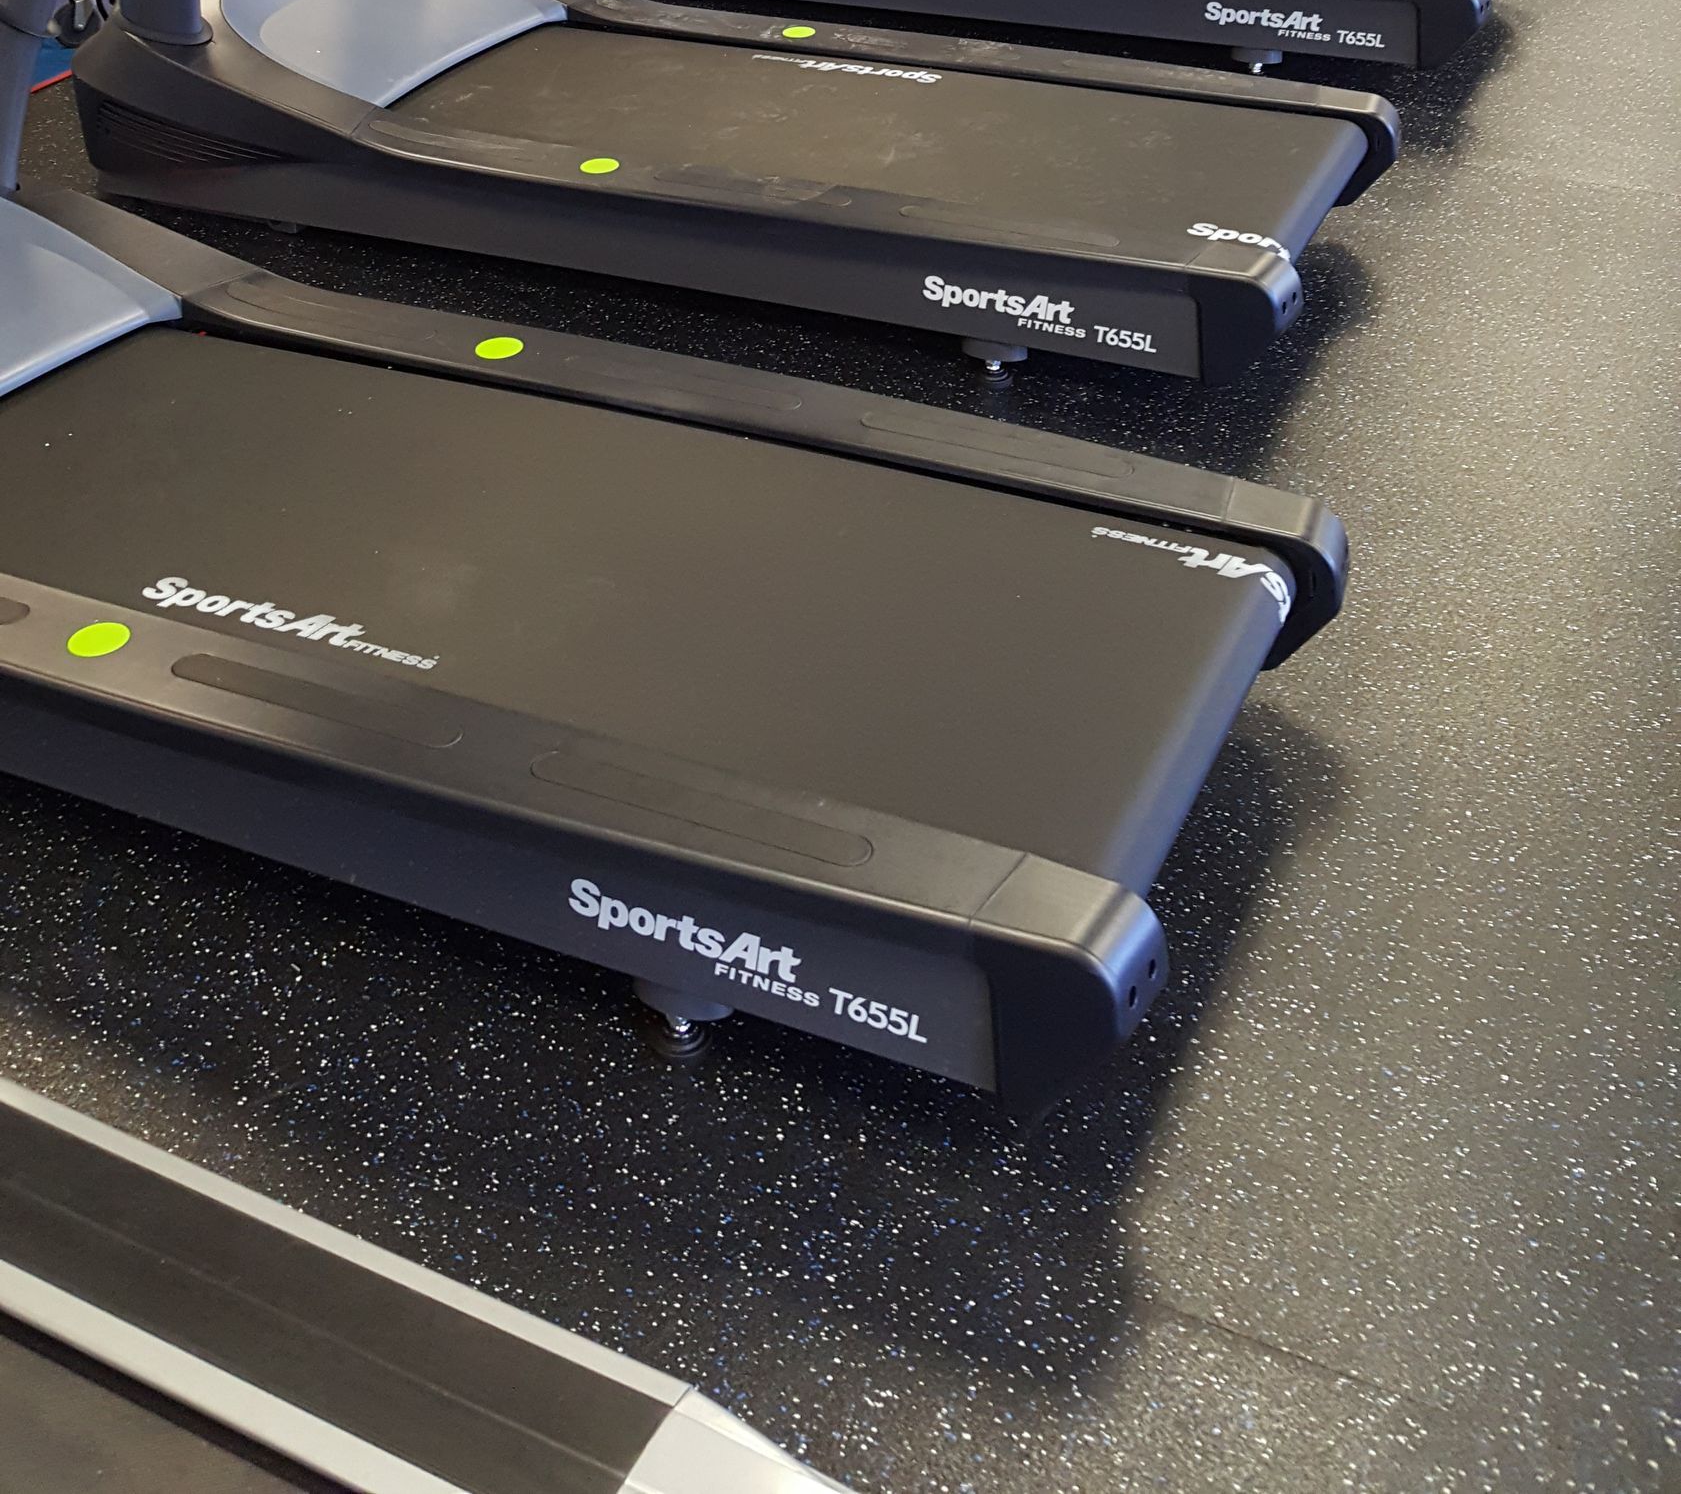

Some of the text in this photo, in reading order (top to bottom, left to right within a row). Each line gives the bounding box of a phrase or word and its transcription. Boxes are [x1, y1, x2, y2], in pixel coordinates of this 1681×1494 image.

[1204, 1, 1323, 32] SportsArt
[1277, 29, 1386, 49] FITNESS T655L
[798, 59, 943, 84] SportsArt
[922, 275, 1075, 325] SportsArt
[1017, 317, 1157, 354] FITNESS T655L
[1091, 526, 1195, 554] FITNESS
[141, 576, 439, 670] SportsArt FITNESS
[567, 878, 802, 983] SportsArt
[713, 962, 928, 1044] FITNESS T655L
